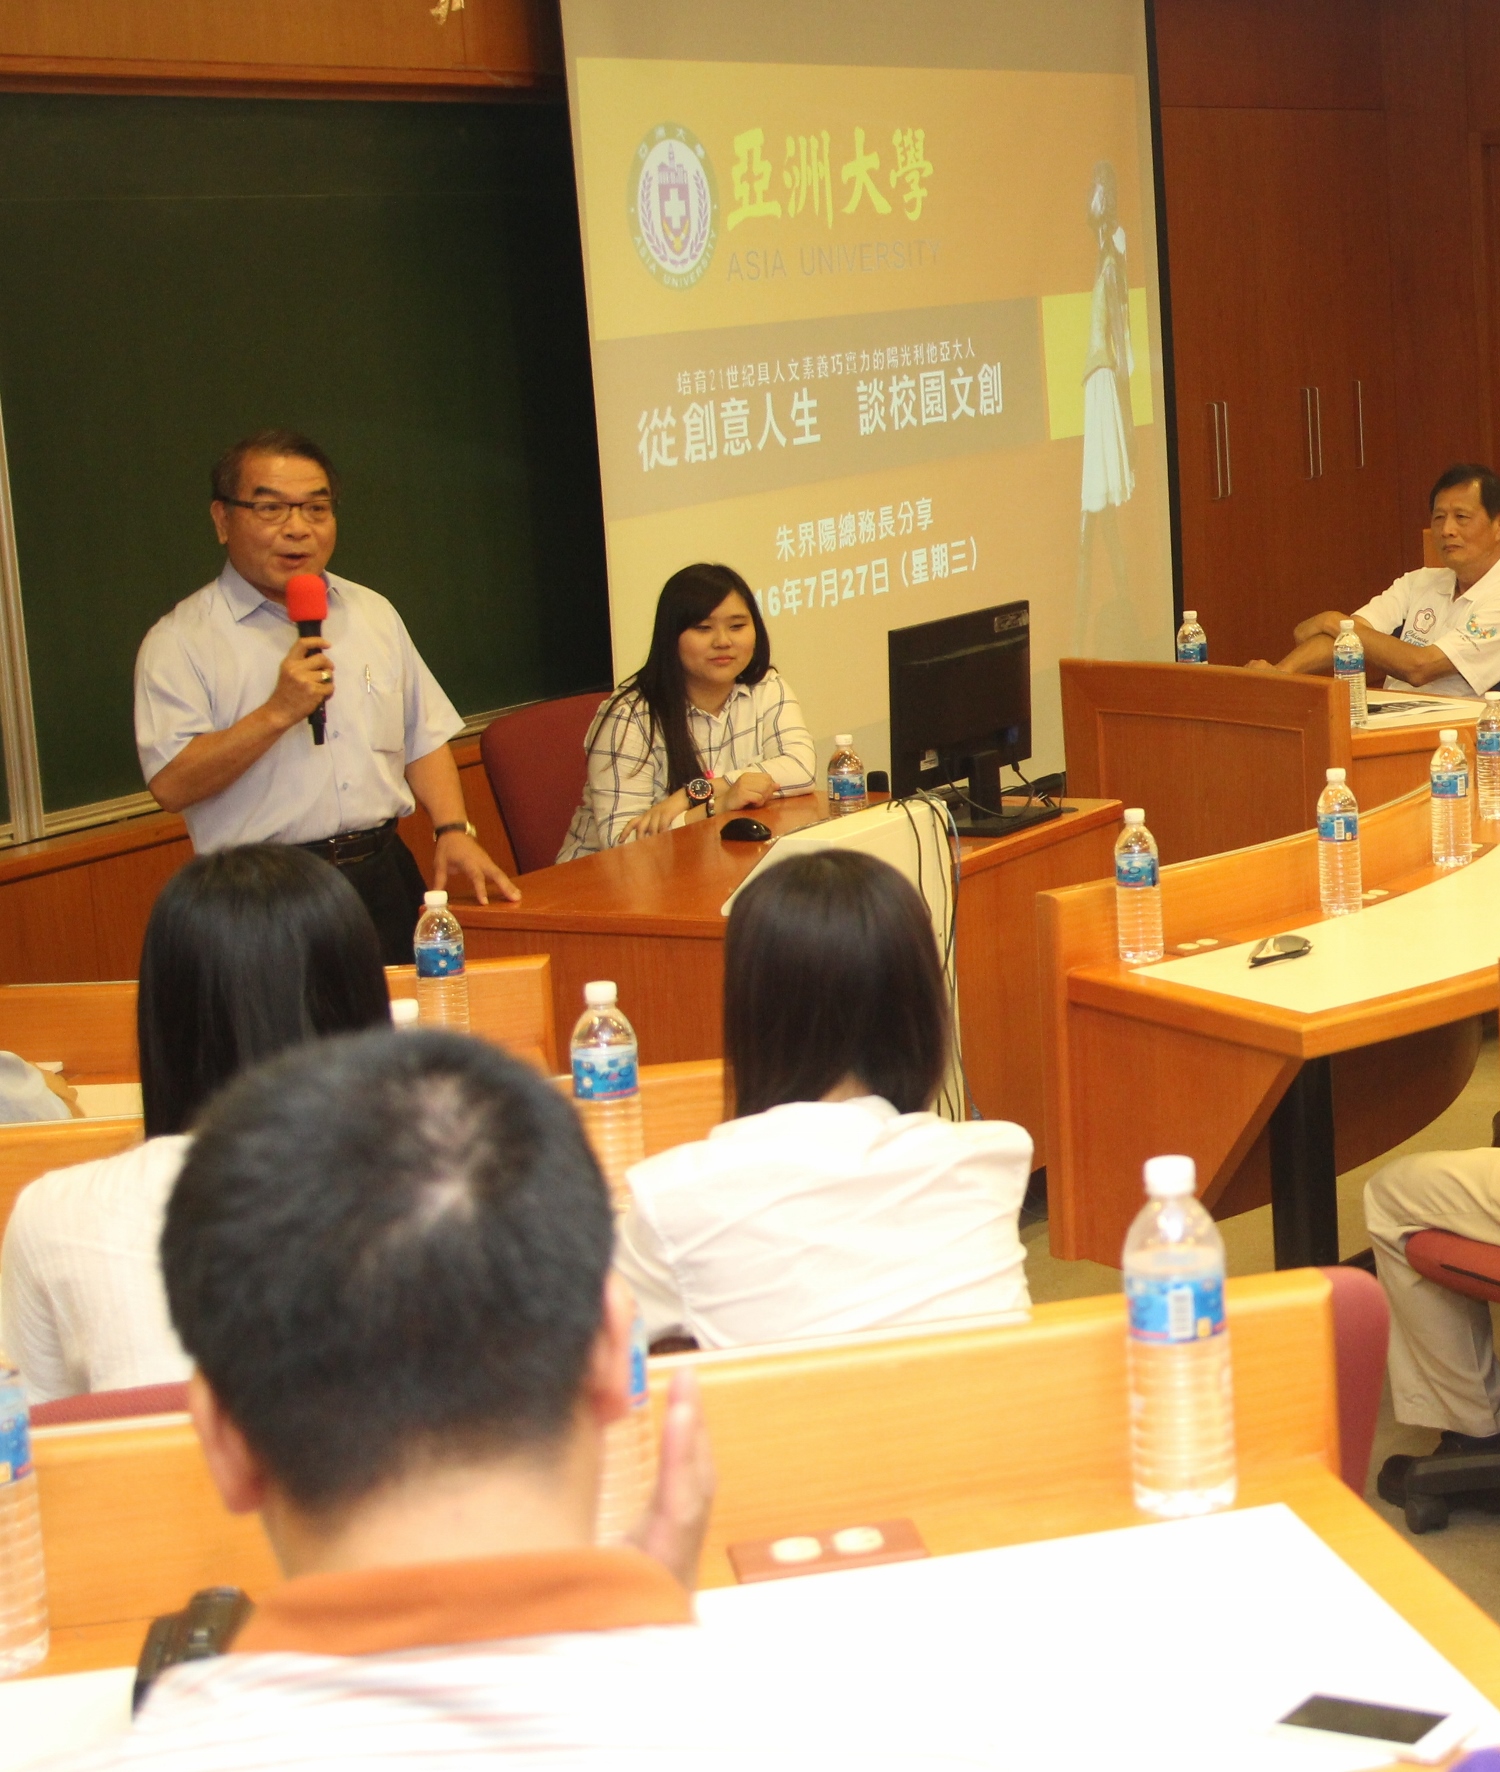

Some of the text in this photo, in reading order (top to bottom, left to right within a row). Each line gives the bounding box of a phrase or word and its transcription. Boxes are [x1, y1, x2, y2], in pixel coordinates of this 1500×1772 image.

[727, 126, 934, 232] 亞洲大學
[727, 238, 941, 282] ASIA UNIVERSITY
[637, 362, 1003, 472] 從創意人生 談校園文創
[776, 497, 933, 562] 朱界陽總務長分享
[1404, 630, 1429, 643] Chinese
